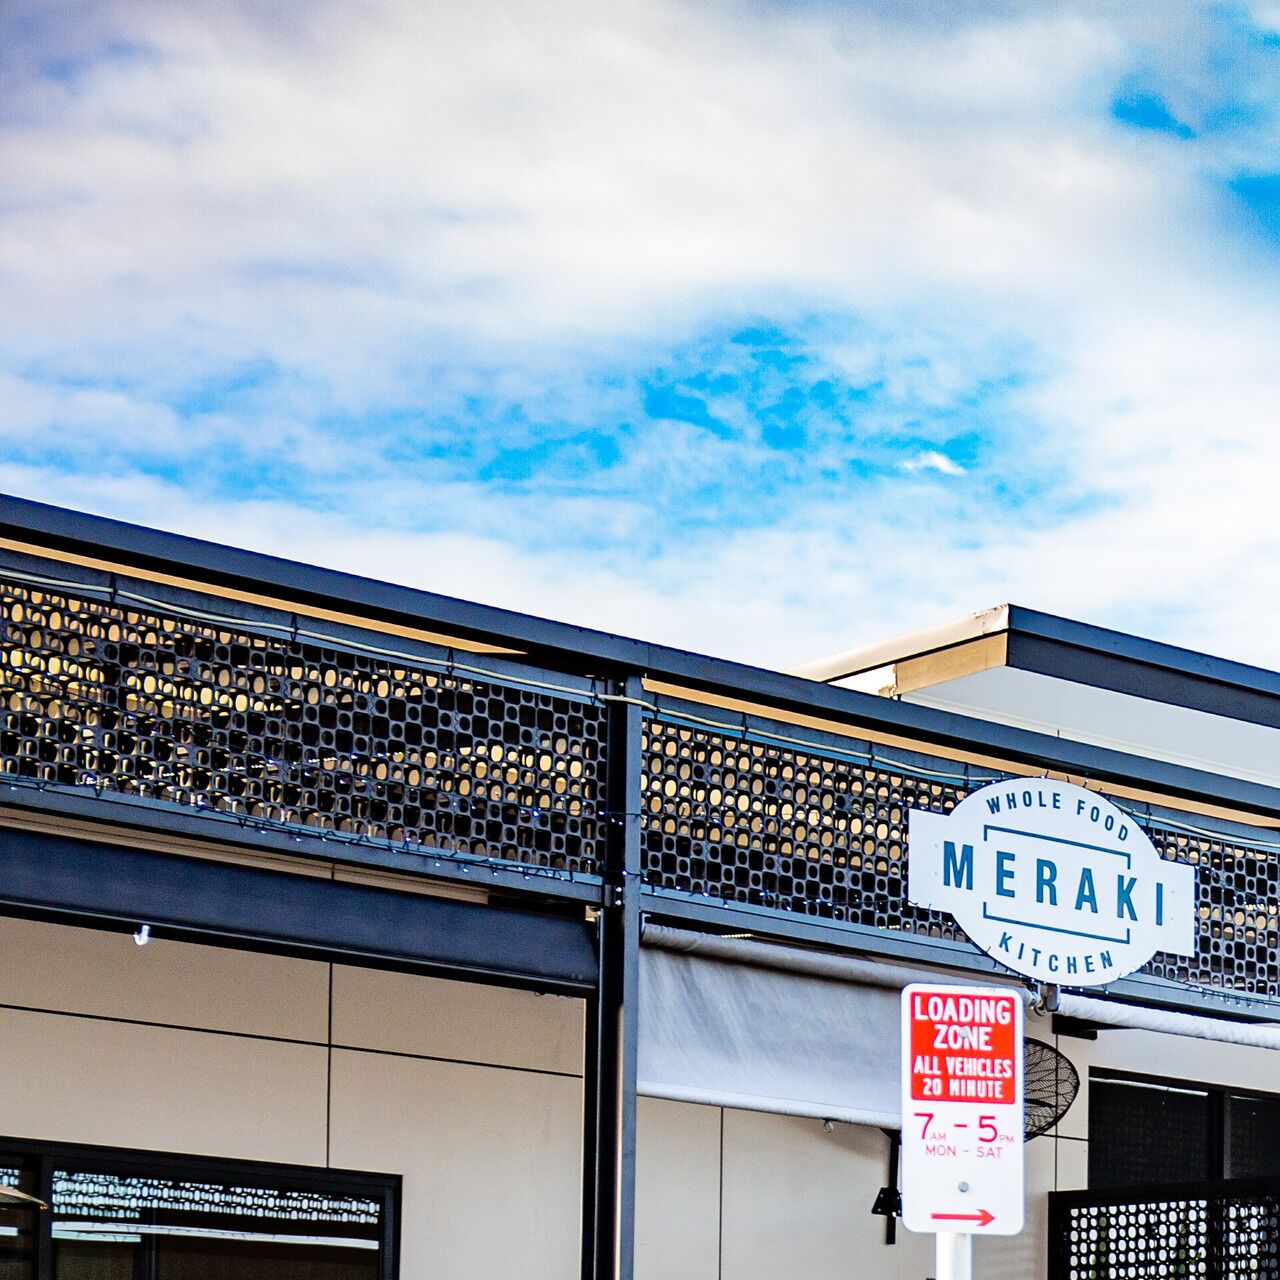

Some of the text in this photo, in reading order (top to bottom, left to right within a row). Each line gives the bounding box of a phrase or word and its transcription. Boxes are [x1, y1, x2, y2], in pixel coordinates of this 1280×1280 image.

[986, 792, 1130, 842] WHOLE FOOD
[943, 840, 1164, 926] MERAKI
[998, 931, 1114, 975] KITCHEN
[914, 996, 1011, 1024] LOADING
[933, 1026, 993, 1052] ZONE
[913, 1057, 1013, 1079] ALL VEHICLES
[922, 1079, 1004, 1099] 20 MINUTE
[925, 1145, 957, 1158] MON
[976, 1146, 1003, 1159] SAT
